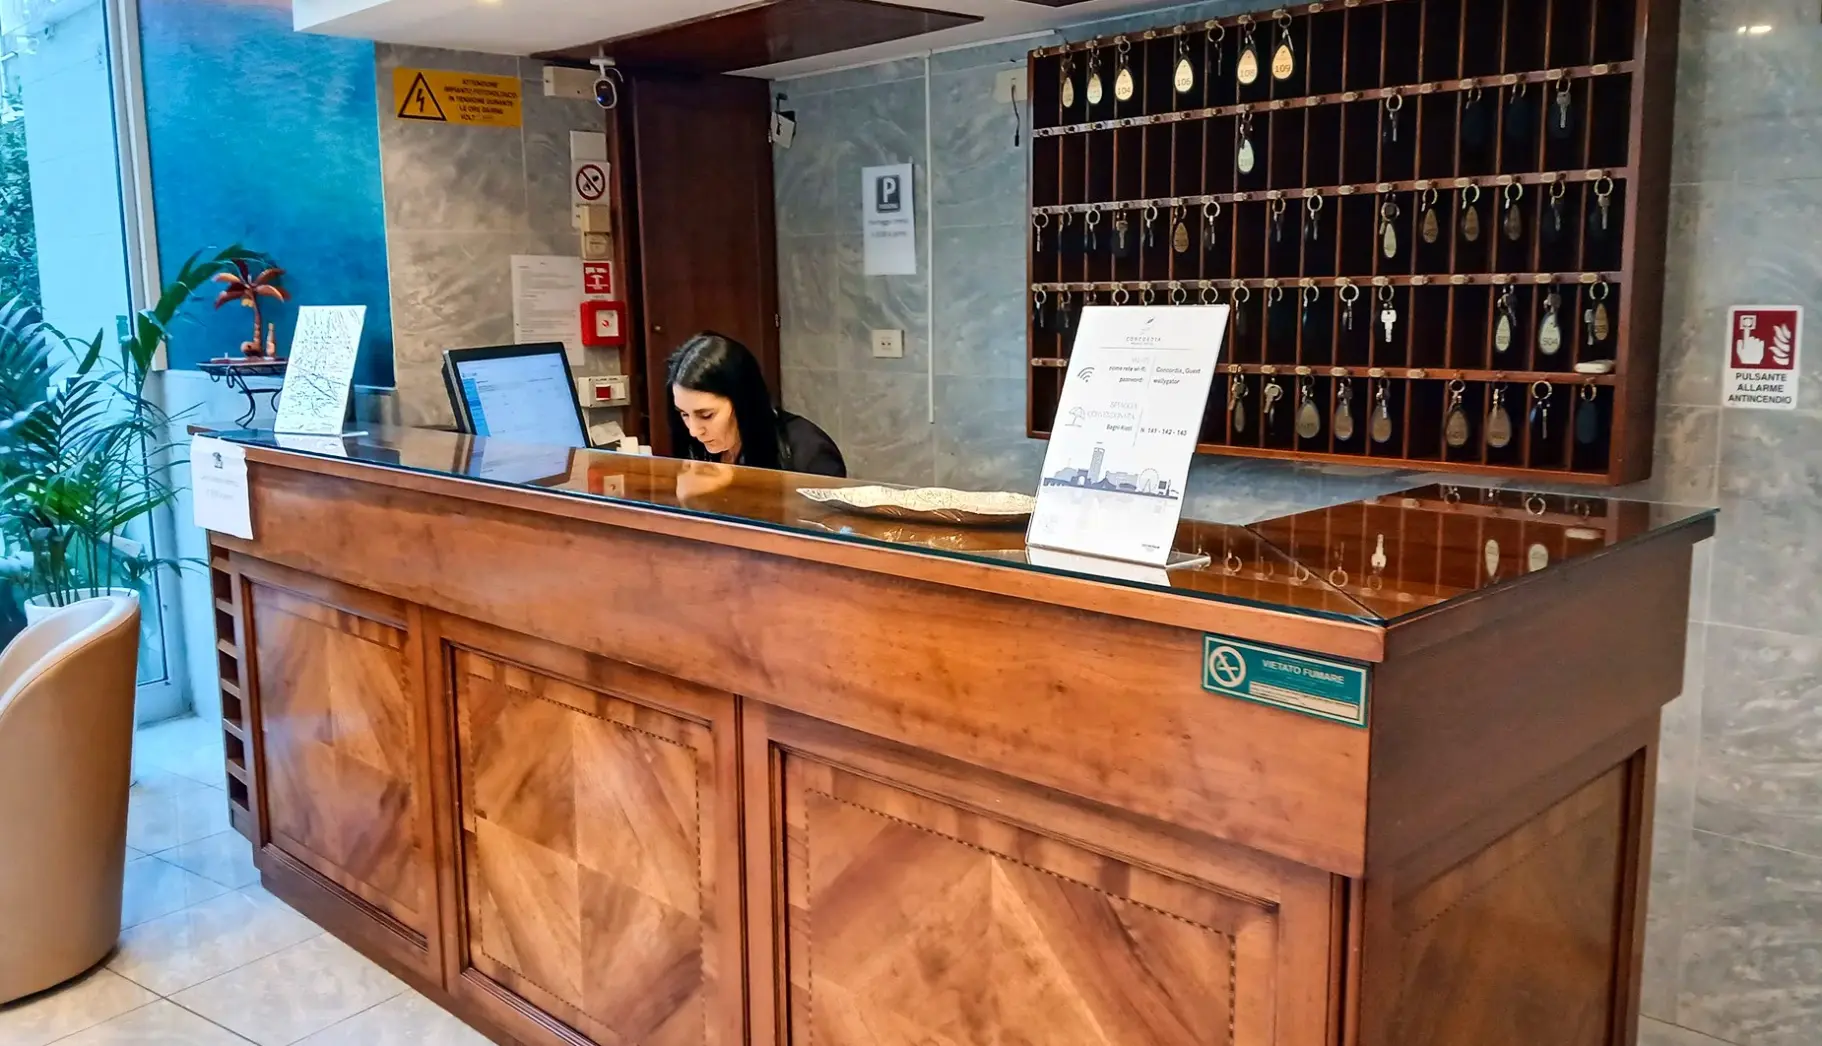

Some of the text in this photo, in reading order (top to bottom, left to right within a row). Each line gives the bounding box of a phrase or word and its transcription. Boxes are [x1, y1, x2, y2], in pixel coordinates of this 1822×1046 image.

[1240, 69, 1255, 78] 108
[1275, 64, 1291, 73] 109
[1118, 86, 1131, 96] 104
[883, 177, 896, 203] P
[1735, 372, 1787, 382] PULSANTE
[1736, 383, 1784, 393] ALLARME
[1727, 394, 1793, 404] ANTINCENDIO
[1262, 659, 1345, 684] VIETATO FUMARE
